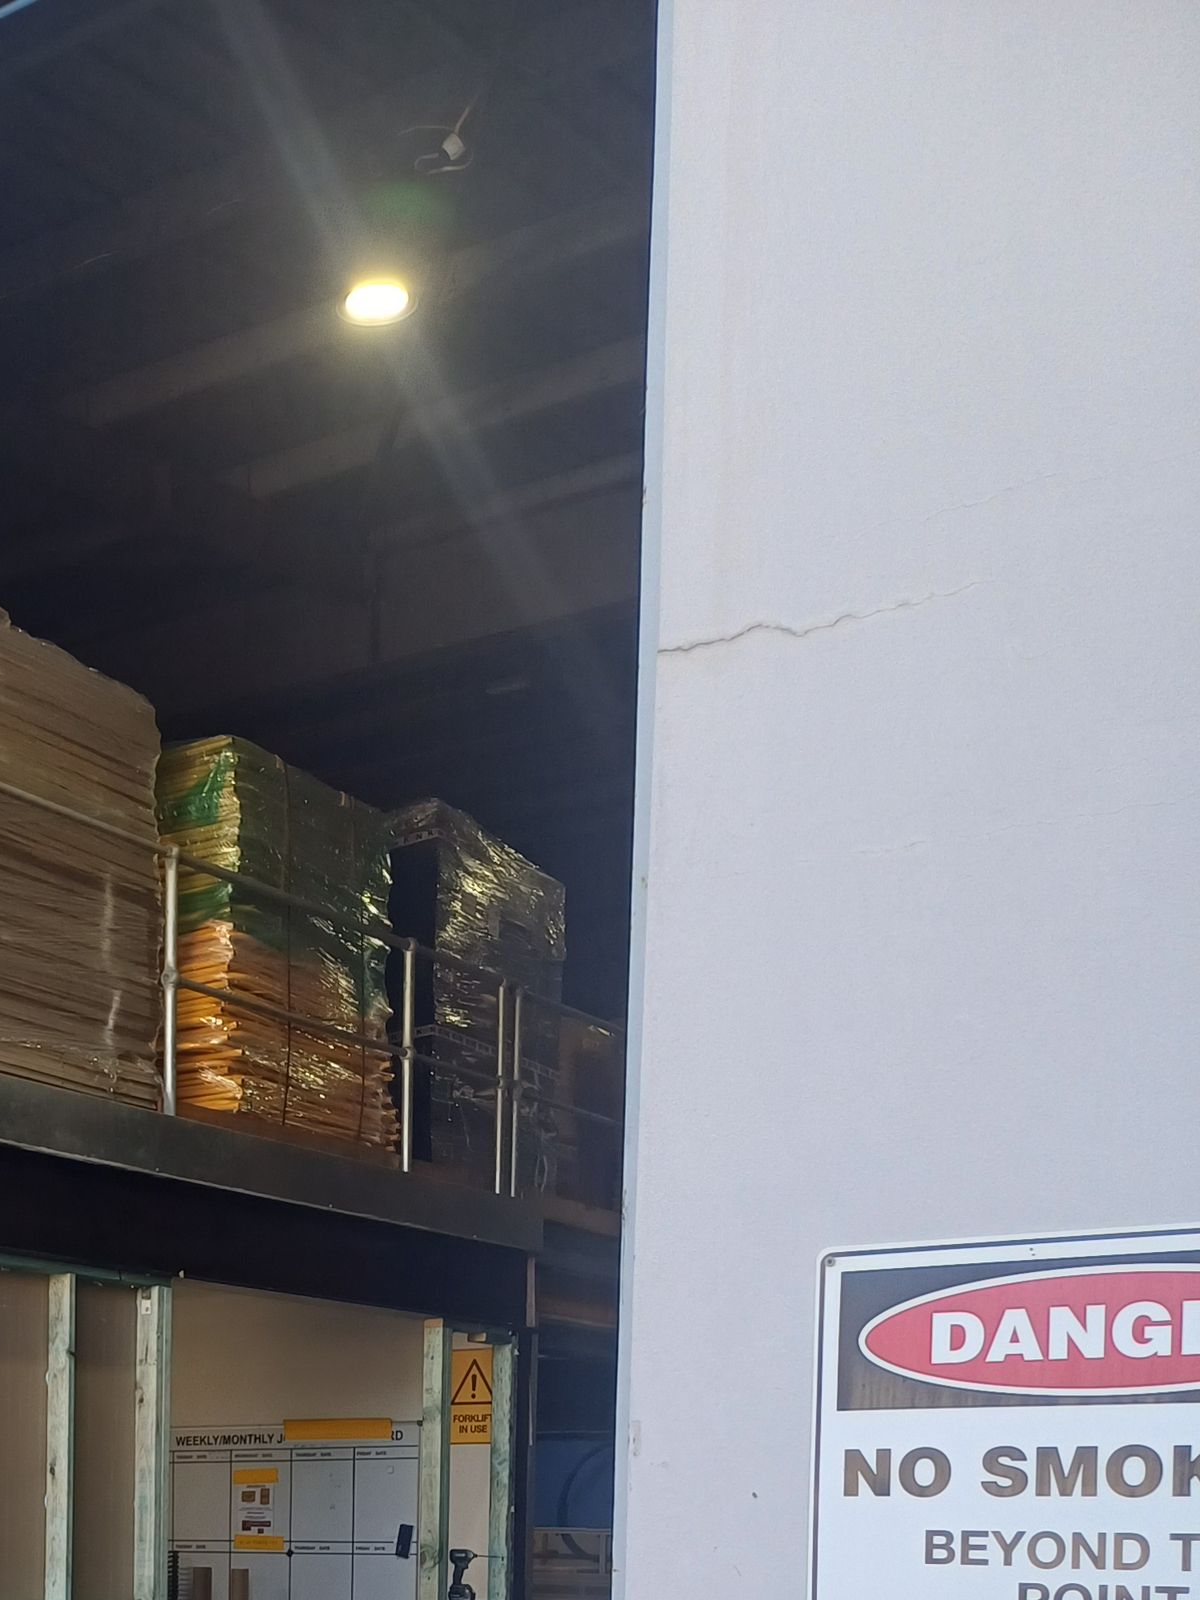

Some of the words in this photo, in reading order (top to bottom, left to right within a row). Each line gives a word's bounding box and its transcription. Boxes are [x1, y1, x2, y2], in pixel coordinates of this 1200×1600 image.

[176, 1434, 274, 1446] WEEKLY/MONTHLY
[459, 1425, 468, 1433] IN
[470, 1425, 487, 1433] USE
[843, 1446, 952, 1498] NO
[924, 1529, 1151, 1571] BEYOND
